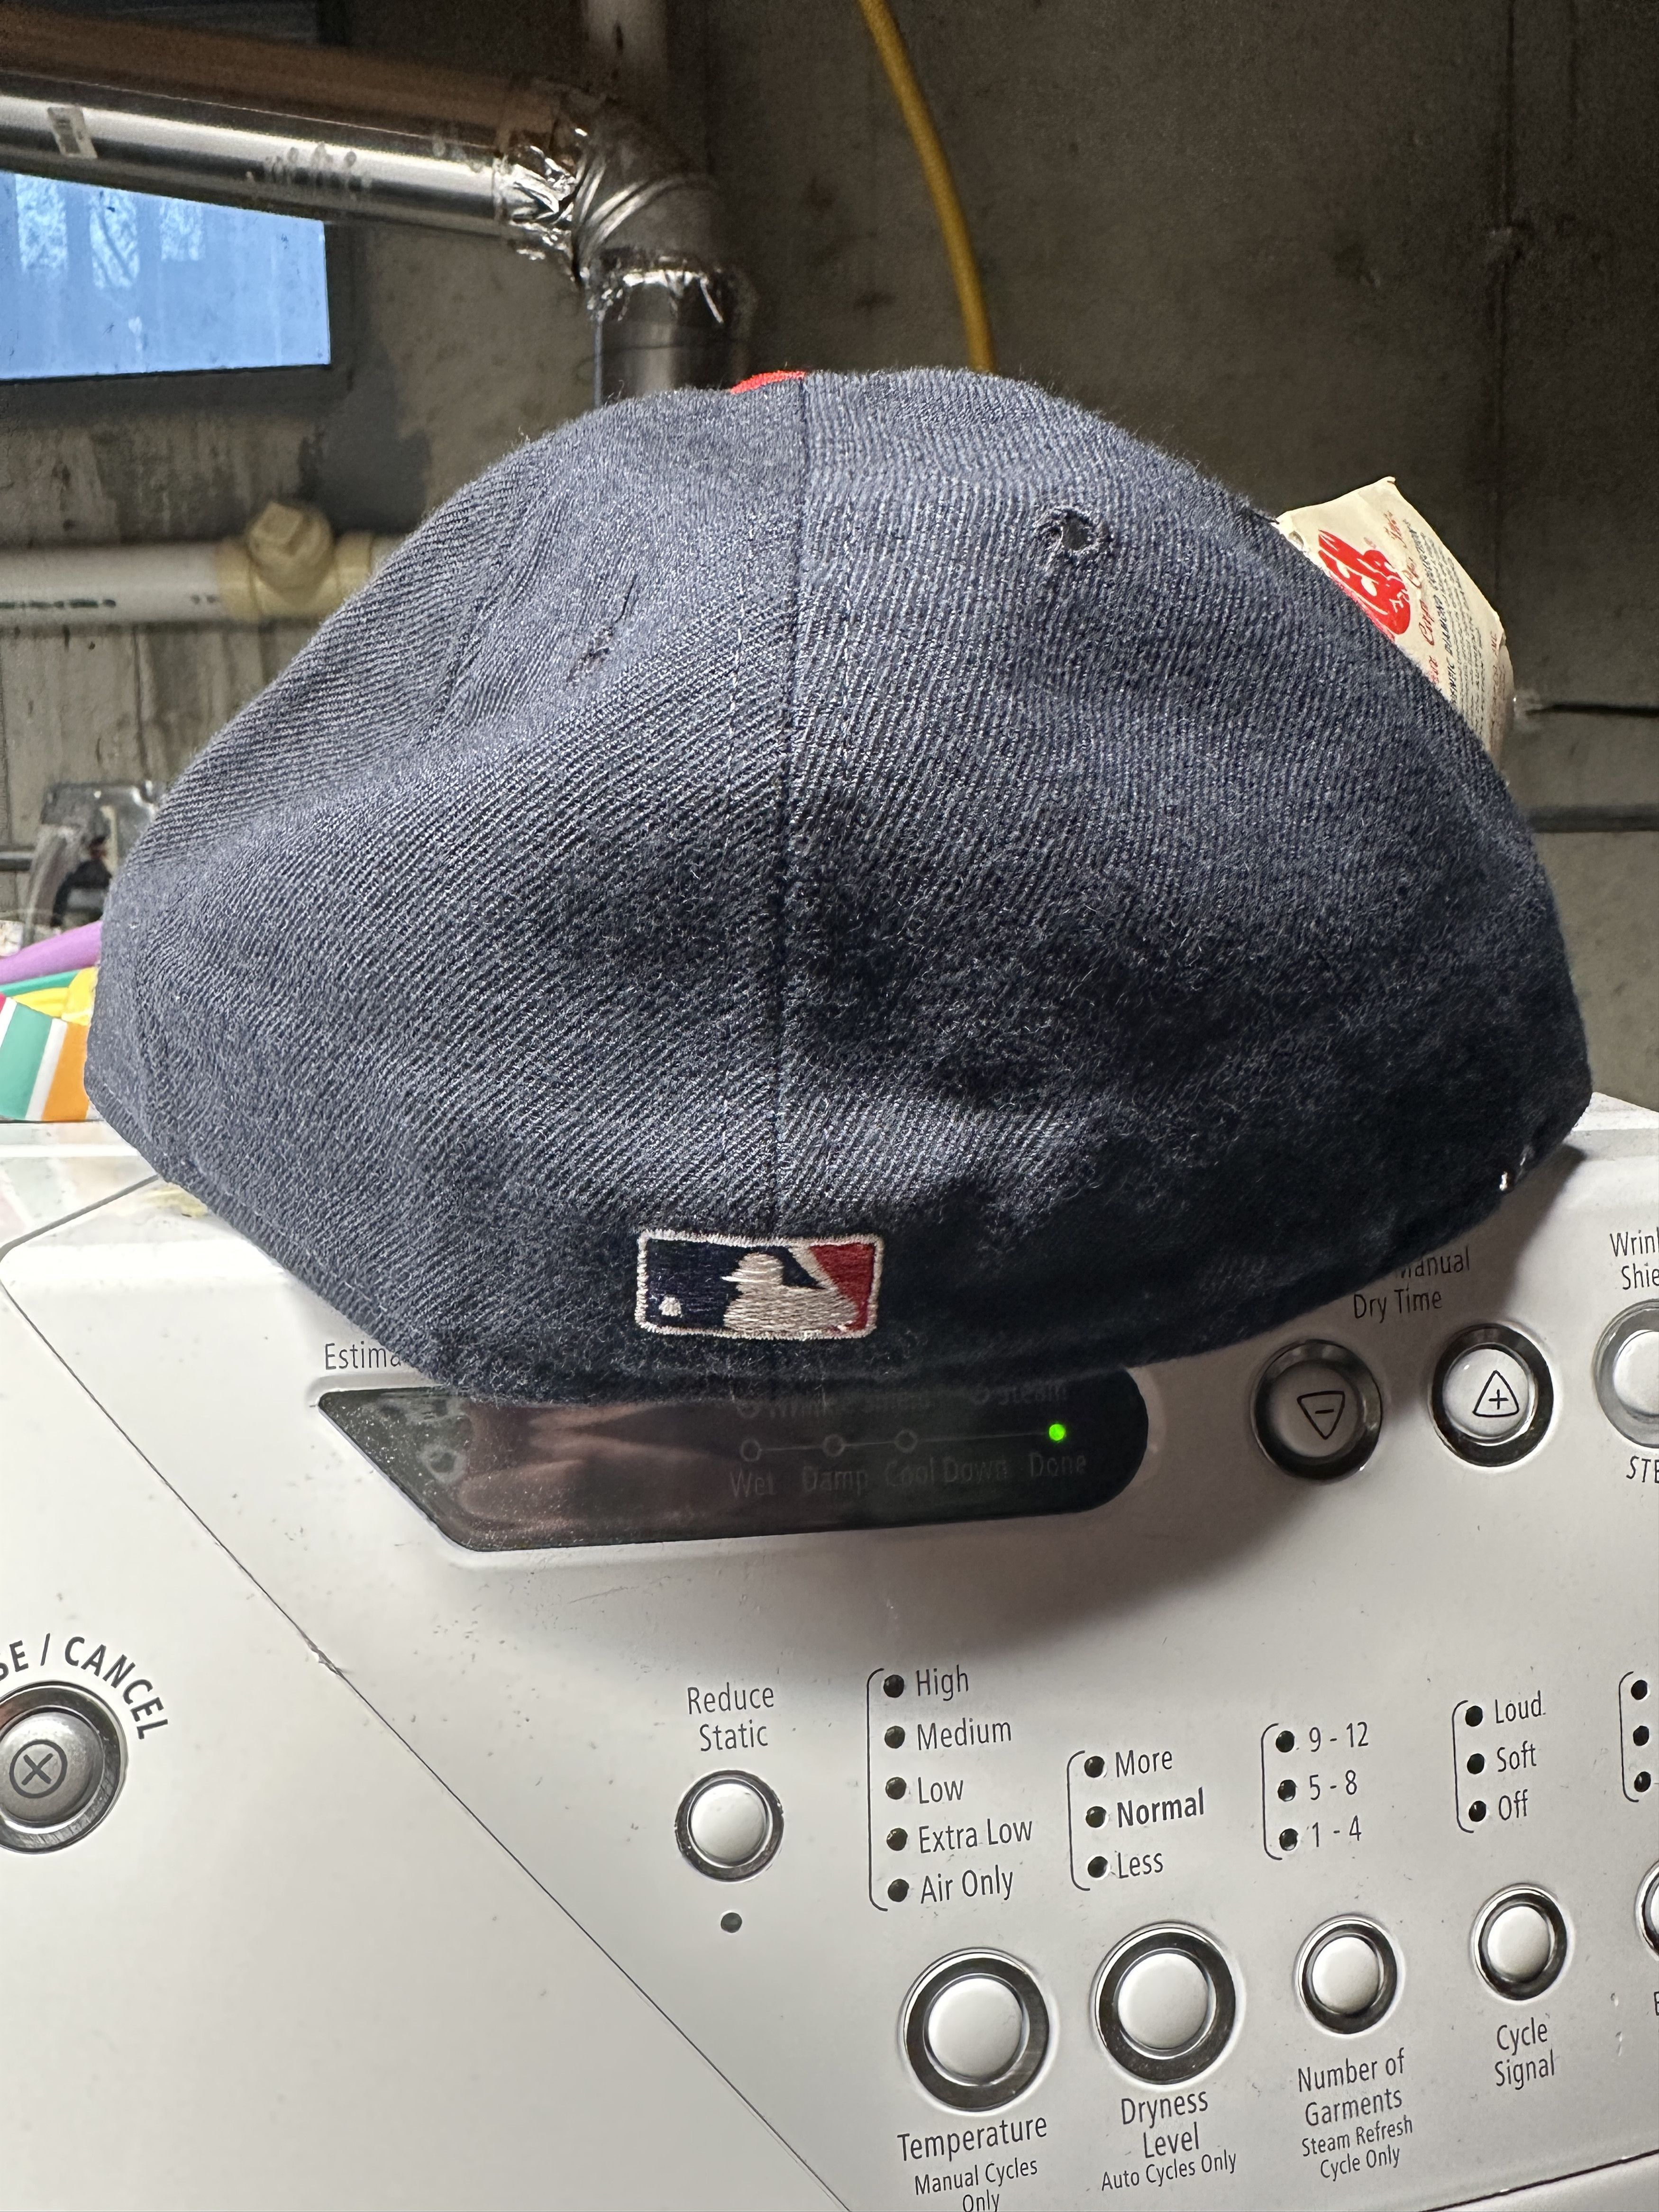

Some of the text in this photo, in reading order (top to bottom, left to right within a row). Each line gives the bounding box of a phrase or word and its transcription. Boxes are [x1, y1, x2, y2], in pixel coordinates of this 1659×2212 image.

[1610, 1227, 1659, 1257] Wrin
[1353, 1285, 1442, 1323] Dry Time
[729, 1450, 1087, 1498] Wet Damp Cool Down Done
[64, 1636, 169, 1740] CANCEL
[687, 1682, 775, 1715] Reduce
[916, 1665, 969, 1702] High
[1495, 1691, 1543, 1724] Loud
[699, 1719, 768, 1752] Static
[917, 1717, 1012, 1751] Medium
[1309, 1727, 1321, 1752] 9
[1346, 1721, 1369, 1748] 12
[1115, 1750, 1173, 1777] More
[1496, 1740, 1538, 1773] Soft
[917, 1777, 964, 1804] Low
[1309, 1774, 1321, 1801] 5
[1345, 1770, 1358, 1795] 8
[1117, 1787, 1204, 1828] Normal
[1498, 1789, 1528, 1821] Off
[918, 1818, 1032, 1855] Extra Low
[1312, 1822, 1320, 1848] 1
[1349, 1815, 1362, 1841] 4
[1117, 1852, 1164, 1879] Less
[920, 1865, 1013, 1904] Air Only
[1496, 2017, 1548, 2056] Cycle
[1297, 2048, 1405, 2092] Number of
[1495, 2049, 1556, 2090] Signal
[1121, 2090, 1208, 2129] Dryness
[1305, 2087, 1403, 2127] Garments
[896, 2116, 1048, 2161] Temperature
[1142, 2122, 1200, 2158] Level
[1302, 2114, 1413, 2157] Steam Refresh
[914, 2157, 1038, 2195] Manual Cycles
[1101, 2149, 1237, 2191] Auto Cycles Only
[1320, 2144, 1400, 2182] Cycle Only
[962, 2189, 1000, 2212] Only
